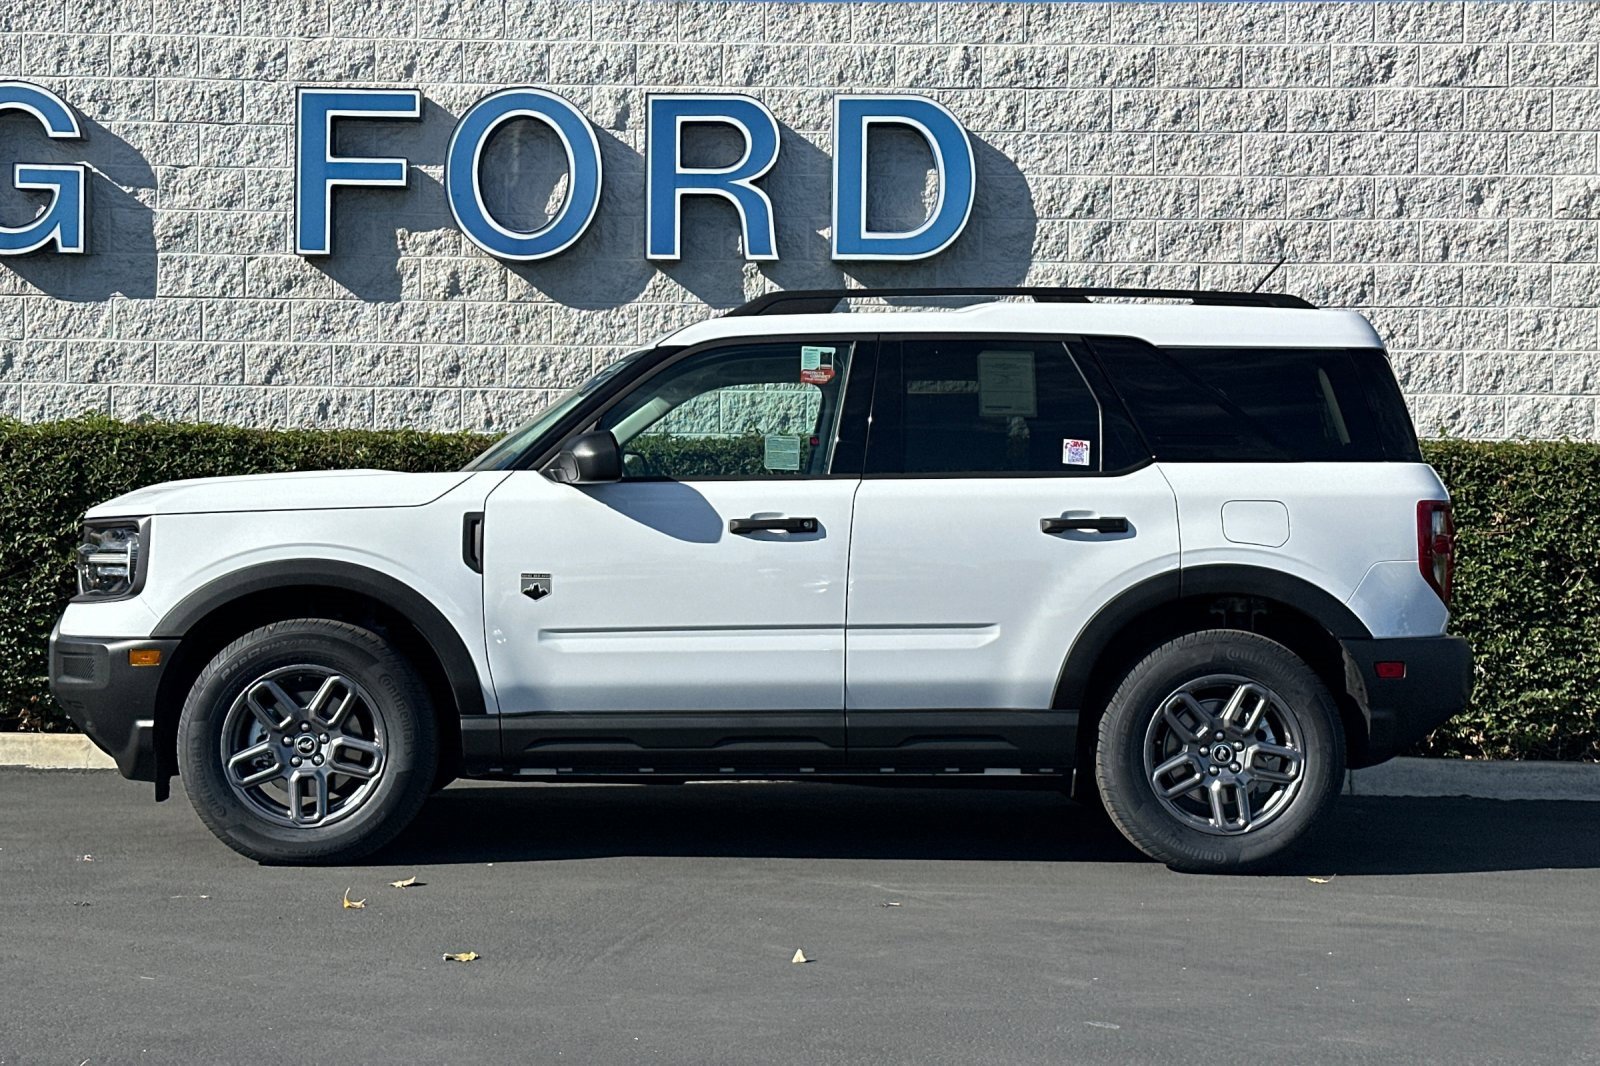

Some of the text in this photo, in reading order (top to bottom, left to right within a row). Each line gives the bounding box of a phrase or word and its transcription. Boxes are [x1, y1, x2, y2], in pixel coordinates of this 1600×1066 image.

[295, 86, 976, 261] FORD
[1070, 440, 1084, 448] 3M
[378, 672, 415, 744] Continental
[1152, 828, 1225, 862] Continental
